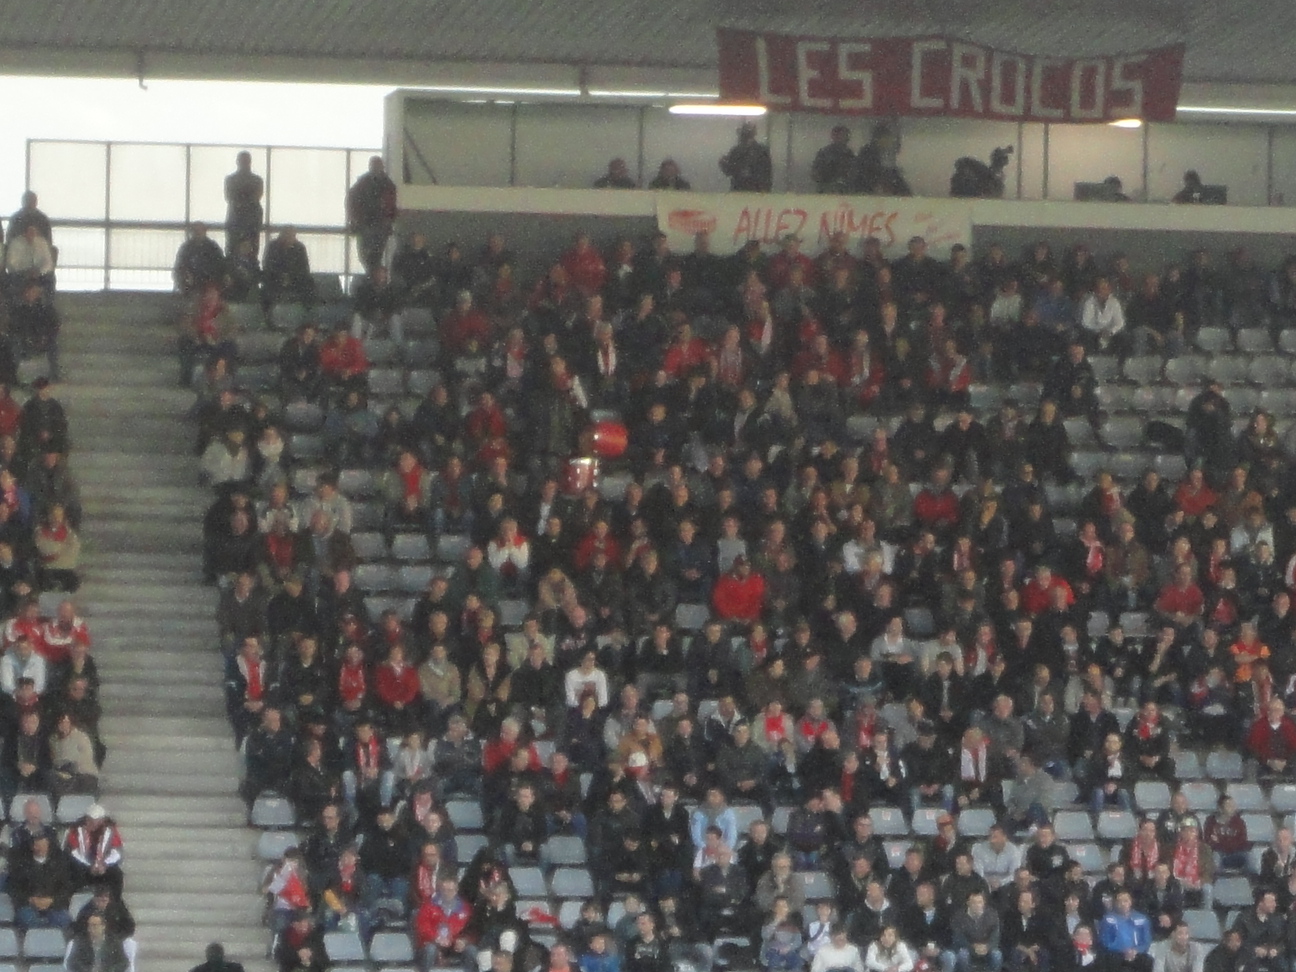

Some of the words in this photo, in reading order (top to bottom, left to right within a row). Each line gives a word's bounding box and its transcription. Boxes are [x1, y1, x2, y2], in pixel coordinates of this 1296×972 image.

[755, 36, 874, 110] LES
[910, 40, 1149, 119] CROCOS
[733, 206, 808, 245] ALLEZ
